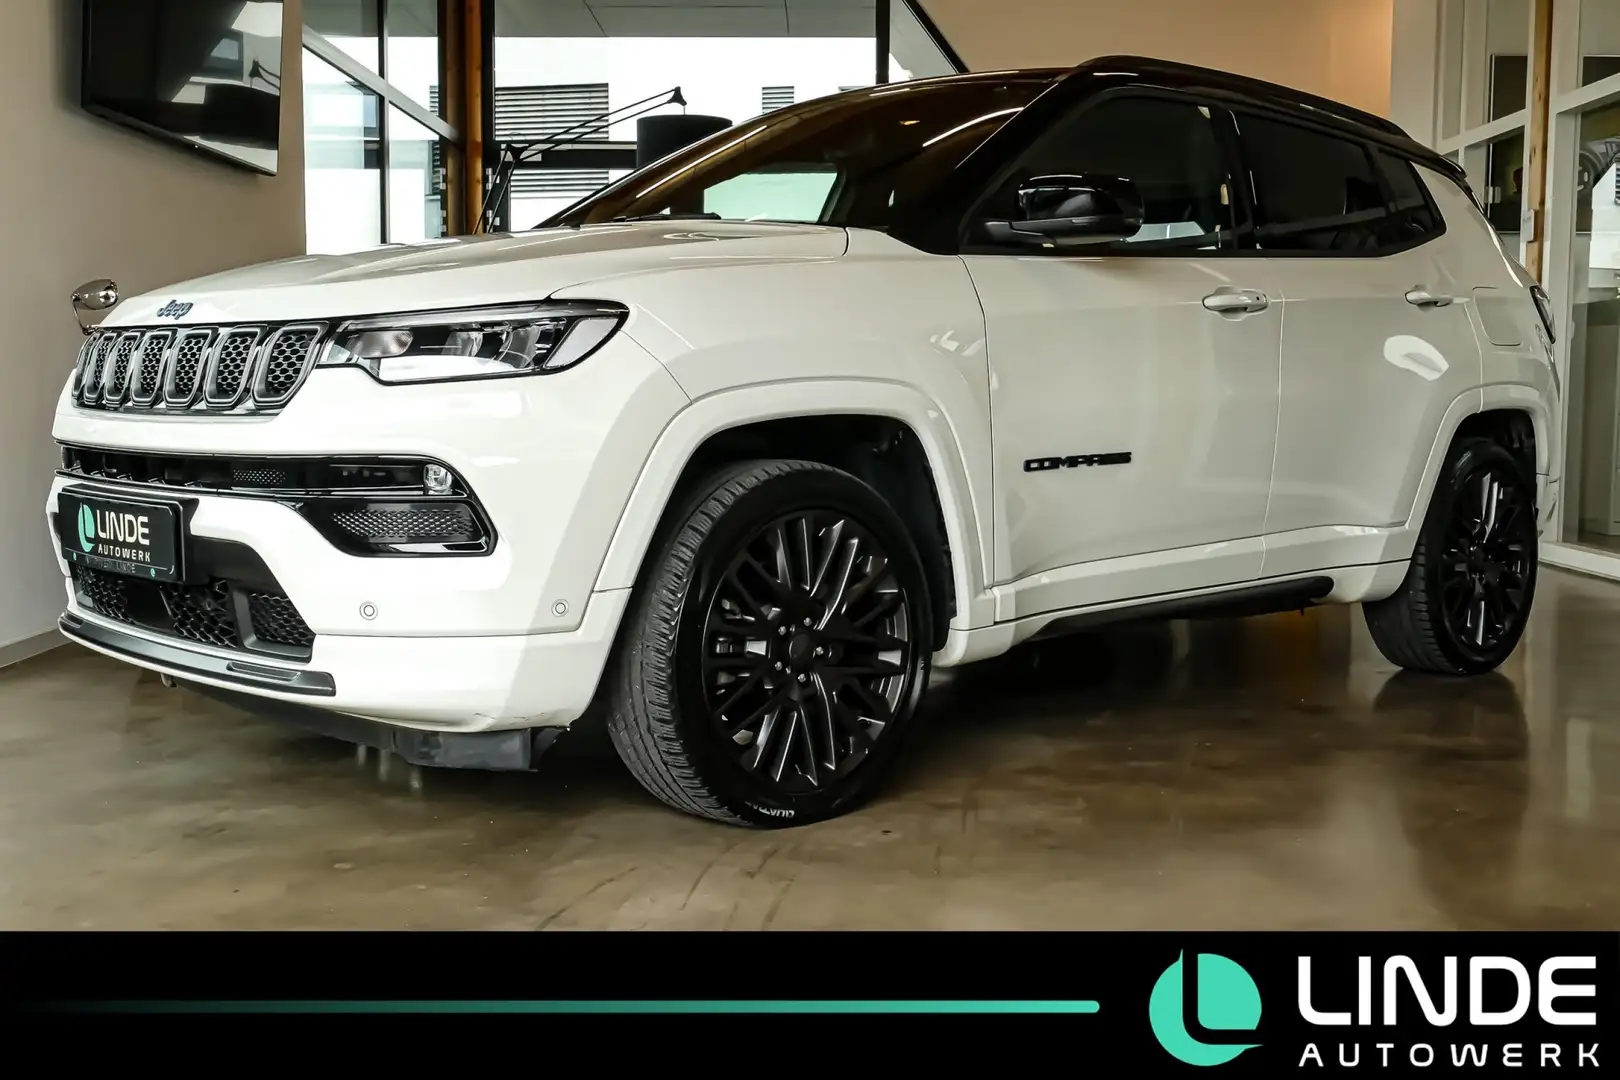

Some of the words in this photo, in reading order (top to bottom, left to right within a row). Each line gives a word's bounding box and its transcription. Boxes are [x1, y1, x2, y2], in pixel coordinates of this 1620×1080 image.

[157, 299, 194, 320] Jeep
[96, 509, 150, 546] LINDE
[98, 543, 151, 563] AUTOWERK
